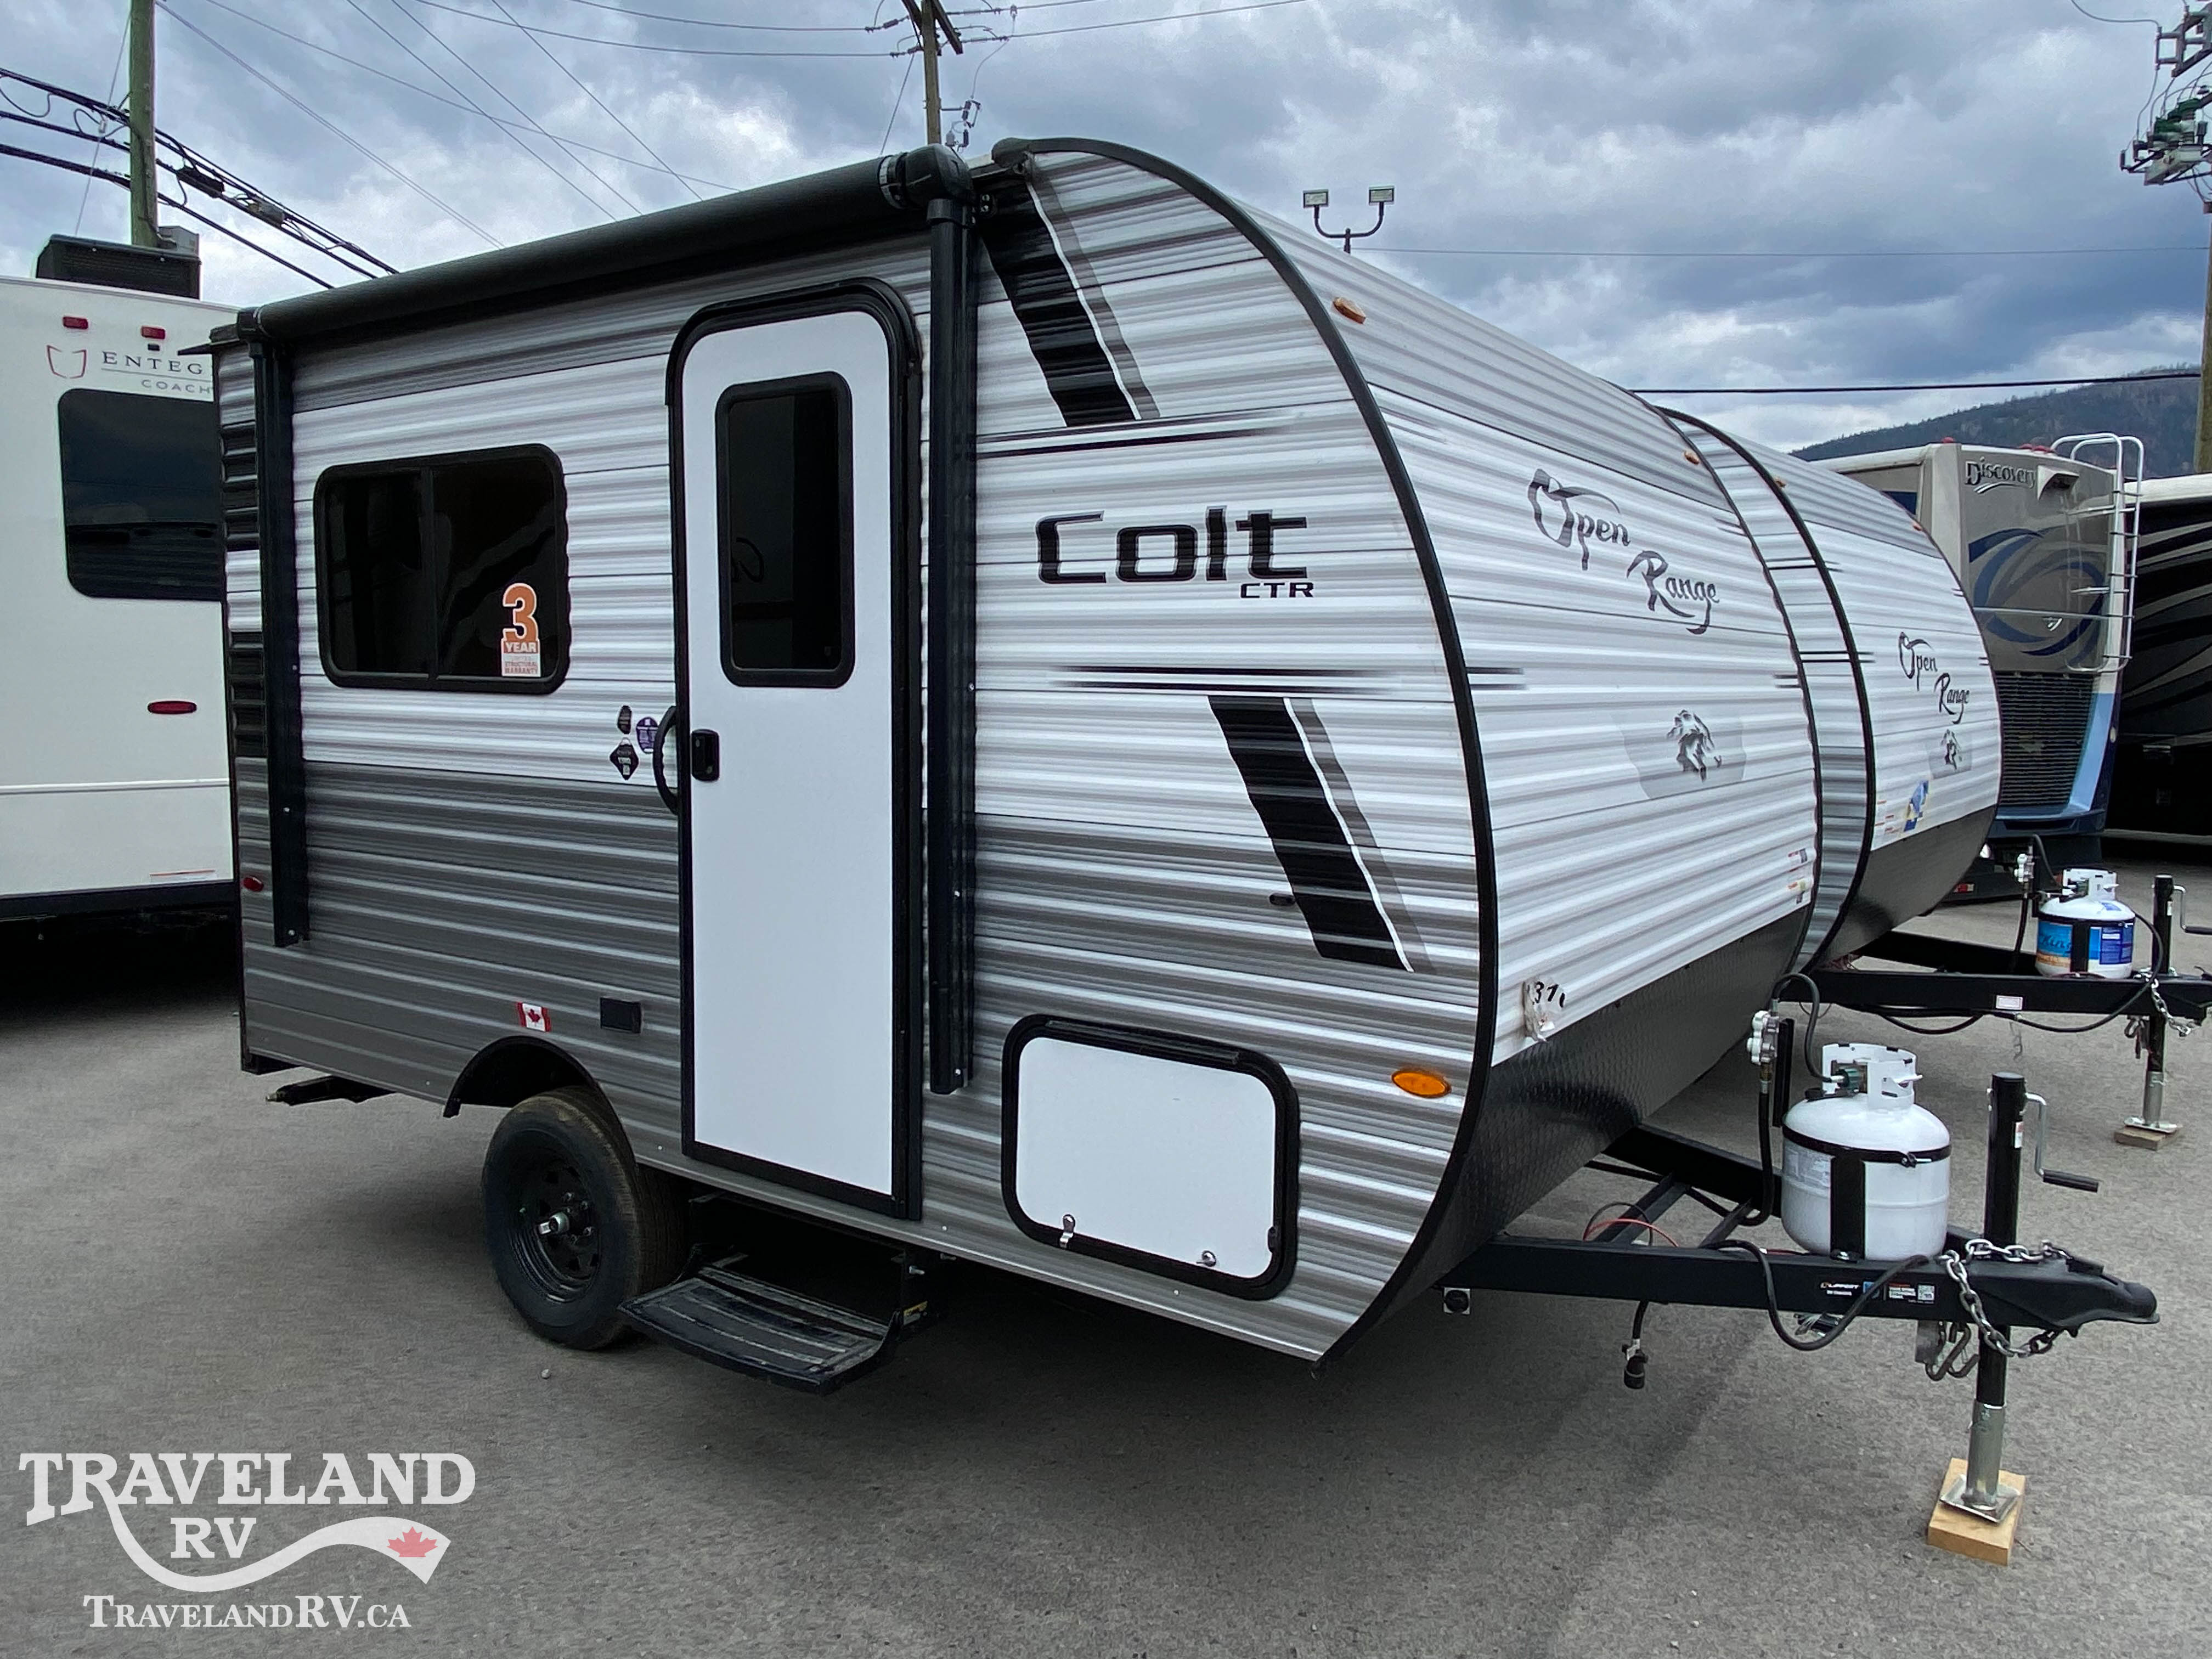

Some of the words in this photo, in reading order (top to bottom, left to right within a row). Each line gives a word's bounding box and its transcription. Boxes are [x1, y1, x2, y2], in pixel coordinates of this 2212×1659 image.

[141, 379, 211, 394] COACH
[1965, 456, 2036, 489] Discovery
[1035, 505, 1307, 584] Colt
[1527, 468, 1631, 571] Open
[1626, 550, 1720, 635] Range
[503, 583, 539, 641] 3
[1240, 582, 1314, 599] CTR
[505, 641, 537, 653] YEAR
[1898, 631, 1938, 691] Open
[1933, 673, 1971, 725] Range
